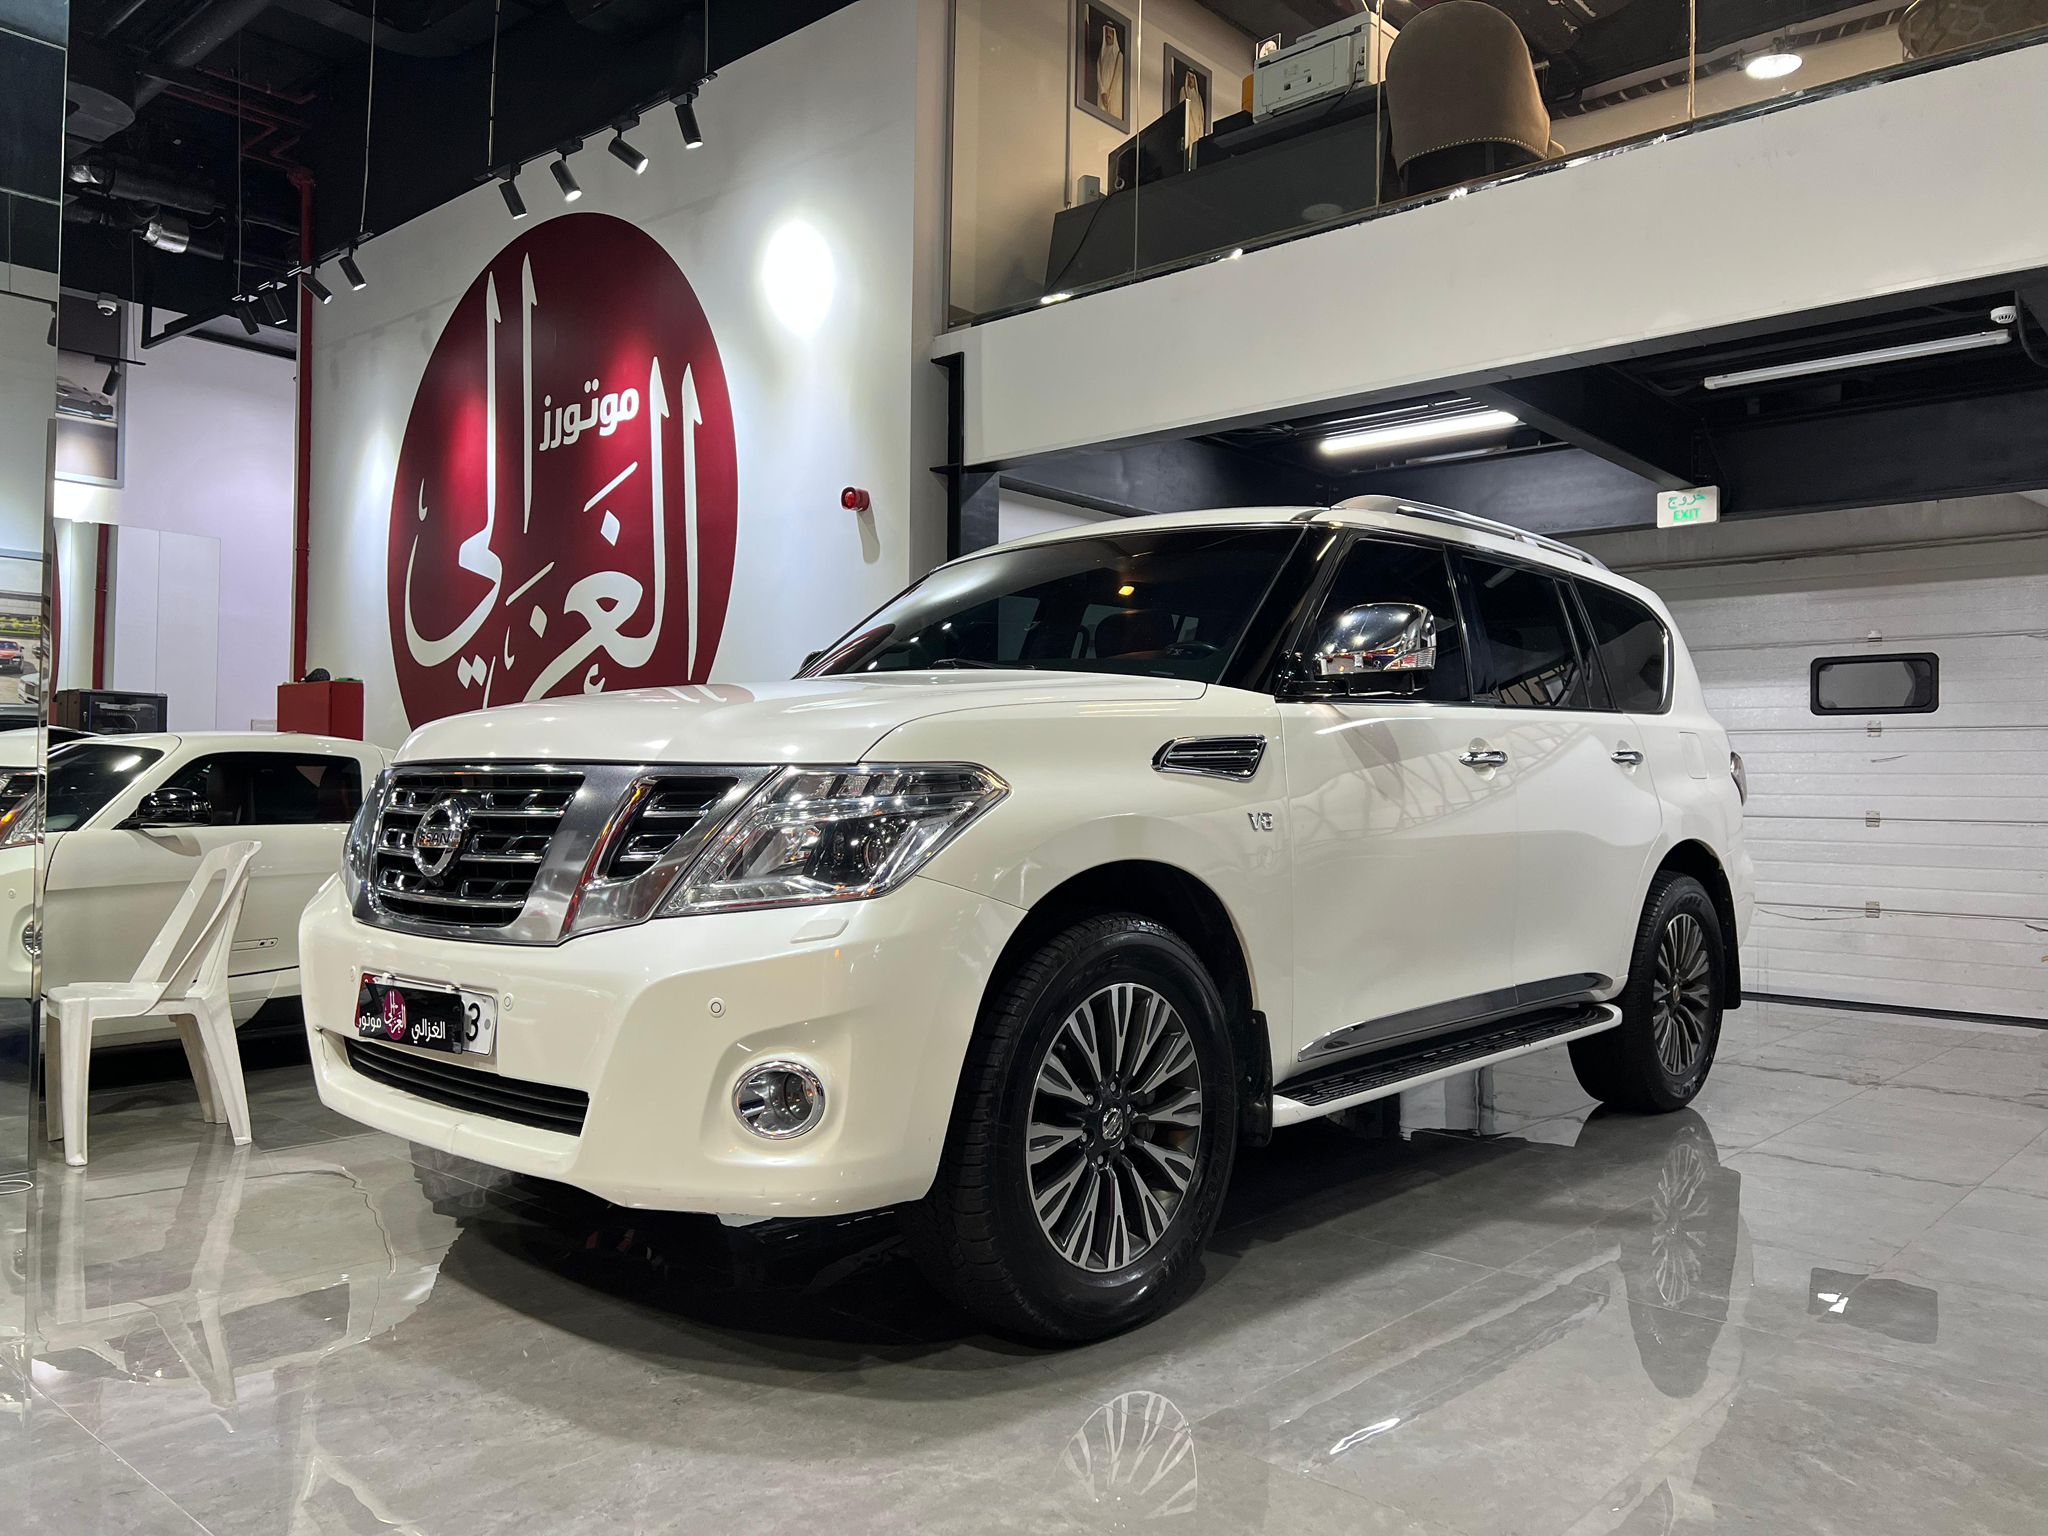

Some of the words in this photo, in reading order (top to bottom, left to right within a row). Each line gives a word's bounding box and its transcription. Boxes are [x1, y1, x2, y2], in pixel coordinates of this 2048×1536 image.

[538, 378, 640, 452] موتورز
[1668, 491, 1707, 509] خروج
[1673, 508, 1701, 522] EXIT
[1247, 812, 1273, 832] V8
[411, 1018, 446, 1044] الغزالي
[465, 1002, 481, 1042] 3
